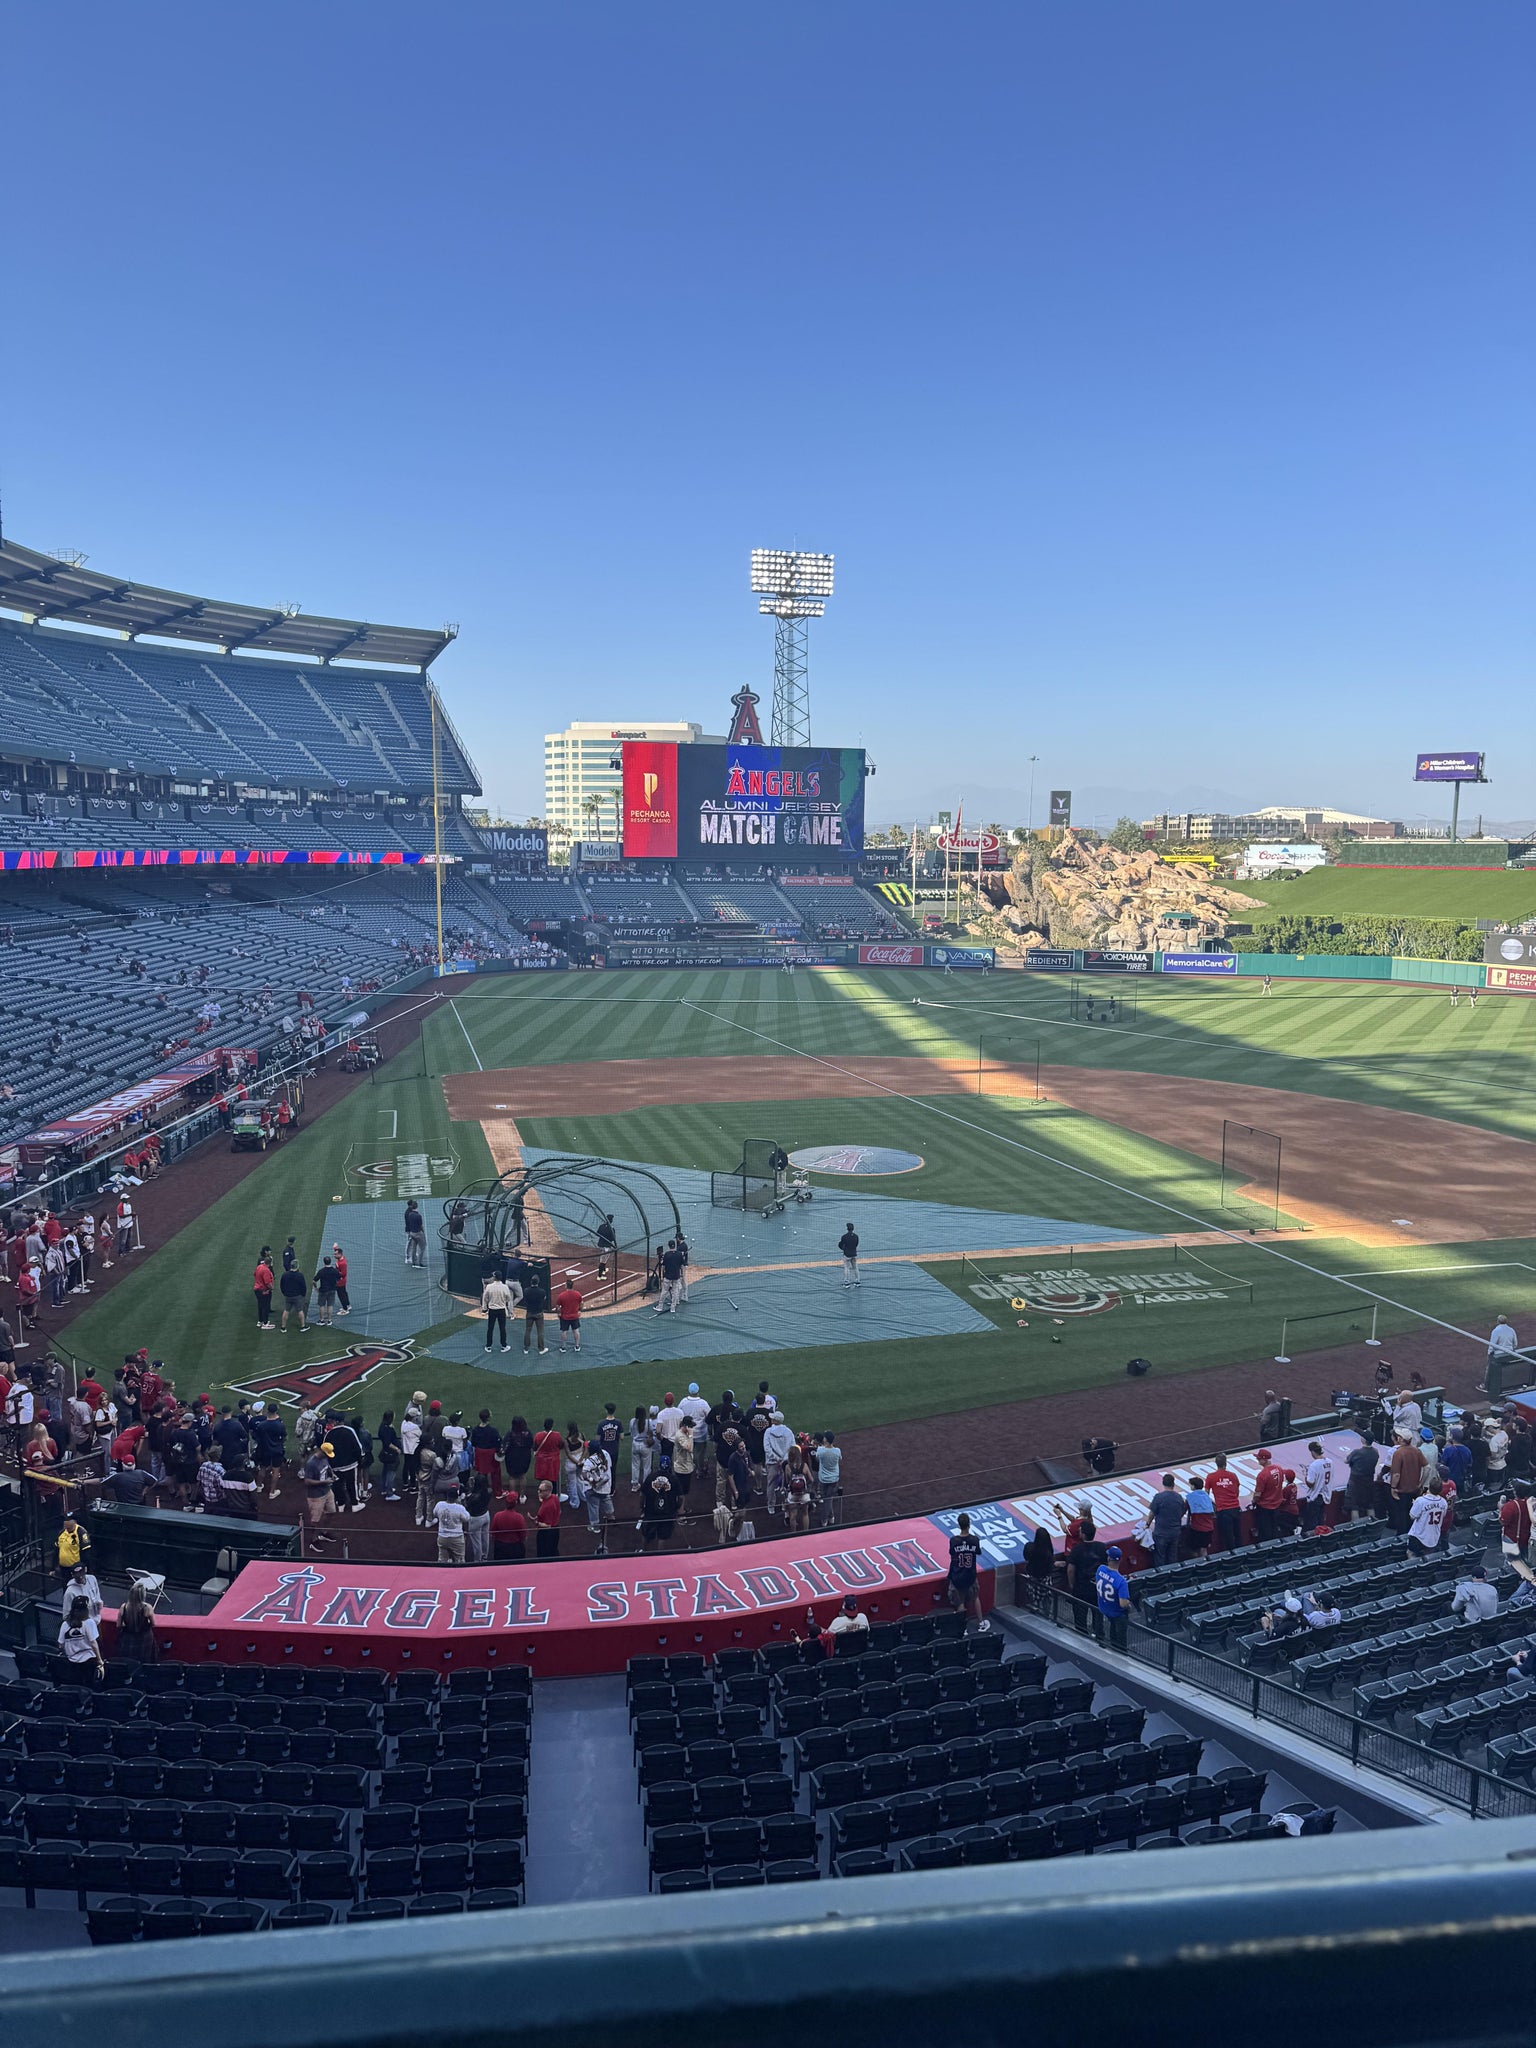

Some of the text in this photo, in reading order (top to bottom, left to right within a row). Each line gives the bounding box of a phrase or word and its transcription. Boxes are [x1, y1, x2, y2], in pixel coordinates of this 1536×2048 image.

[725, 759, 820, 797] ANGELS
[700, 800, 842, 812] ALUMNI JERSEY
[631, 810, 670, 818] PECHANGA
[700, 814, 842, 845] MATCH GAME
[493, 831, 544, 851] Modelo
[586, 844, 616, 856] Modelo
[867, 947, 914, 962] Coca-Cola
[948, 952, 993, 961] VANDA
[1103, 953, 1149, 961] YOKOHAMA
[523, 959, 547, 968] Modelo
[1166, 959, 1223, 968] MemorialCare
[1034, 1269, 1091, 1280] 2026
[968, 1272, 1212, 1300] OPENING WEEK
[1135, 1290, 1229, 1305] Adobe
[1428, 1511, 1442, 1525] 13
[958, 1553, 973, 1568] 13
[234, 1538, 947, 1630] ANGEL STADIUM
[1096, 1579, 1115, 1601] 42
